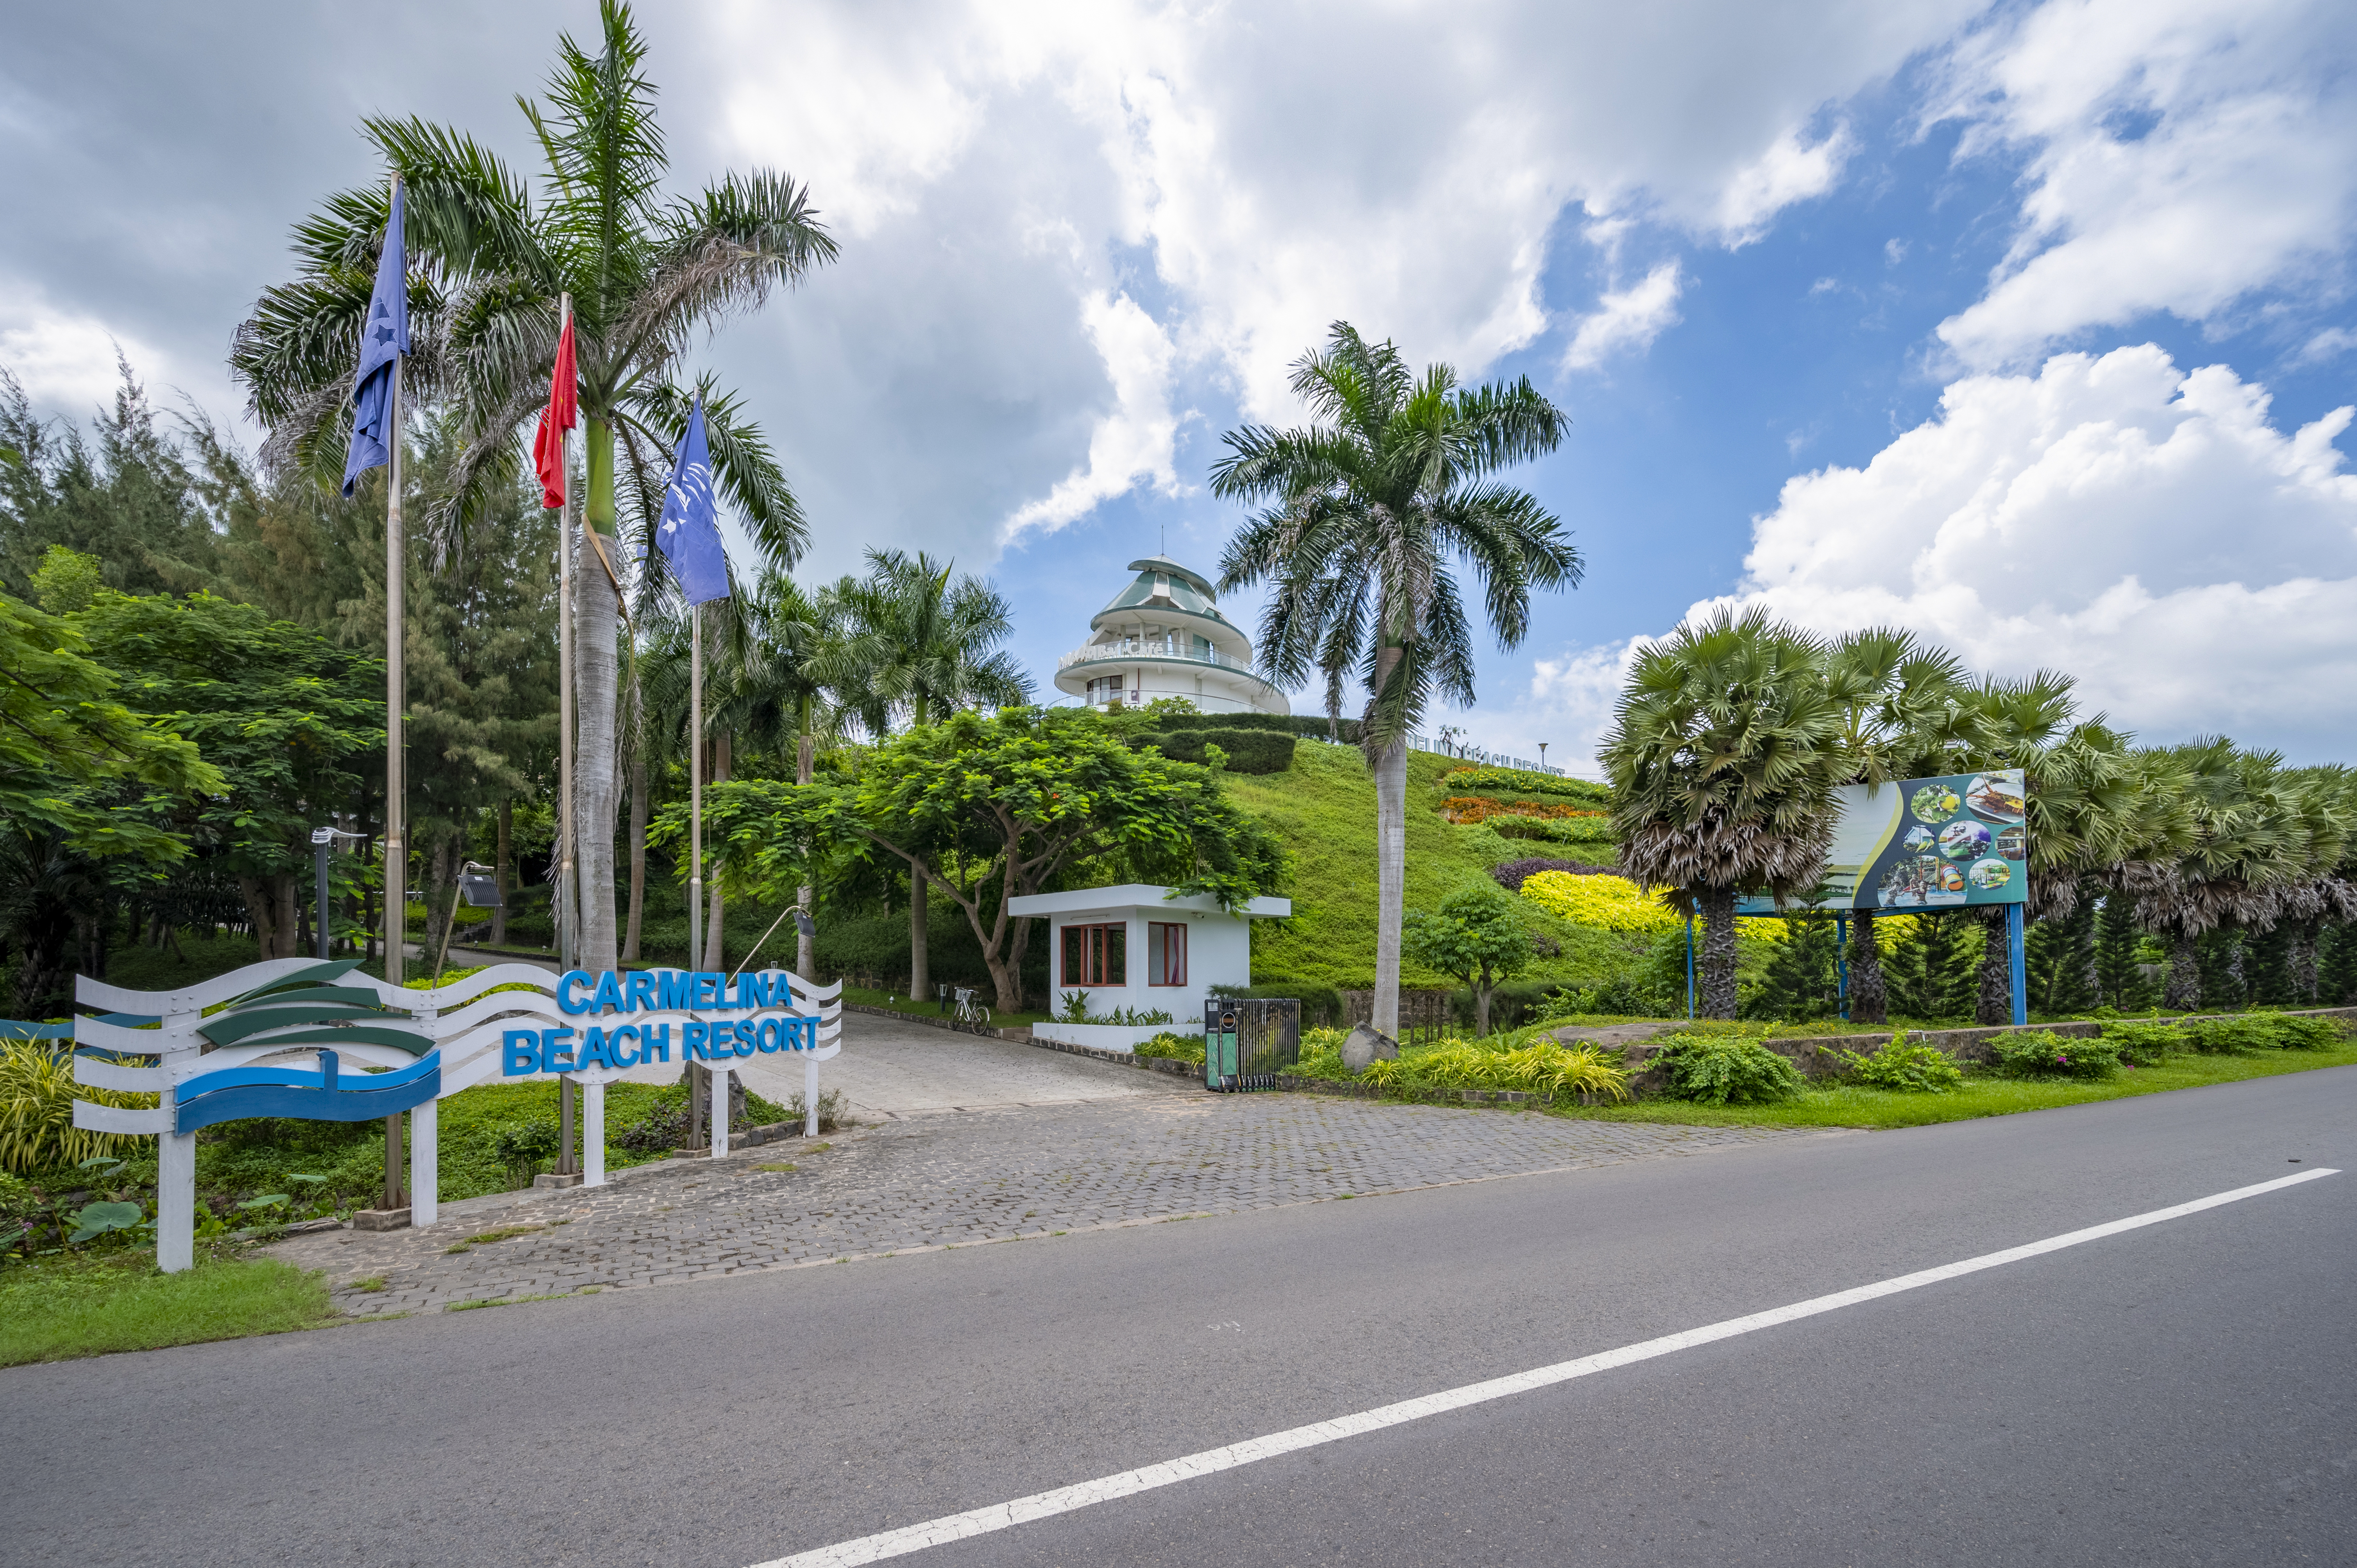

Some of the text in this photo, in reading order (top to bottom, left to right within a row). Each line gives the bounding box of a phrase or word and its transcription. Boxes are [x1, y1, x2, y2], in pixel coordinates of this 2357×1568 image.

[1097, 642, 1163, 657] Bar Café
[1463, 746, 1510, 768] BEACH
[557, 970, 793, 1015] CARMELINA
[502, 1016, 822, 1077] BEACH RESORT
